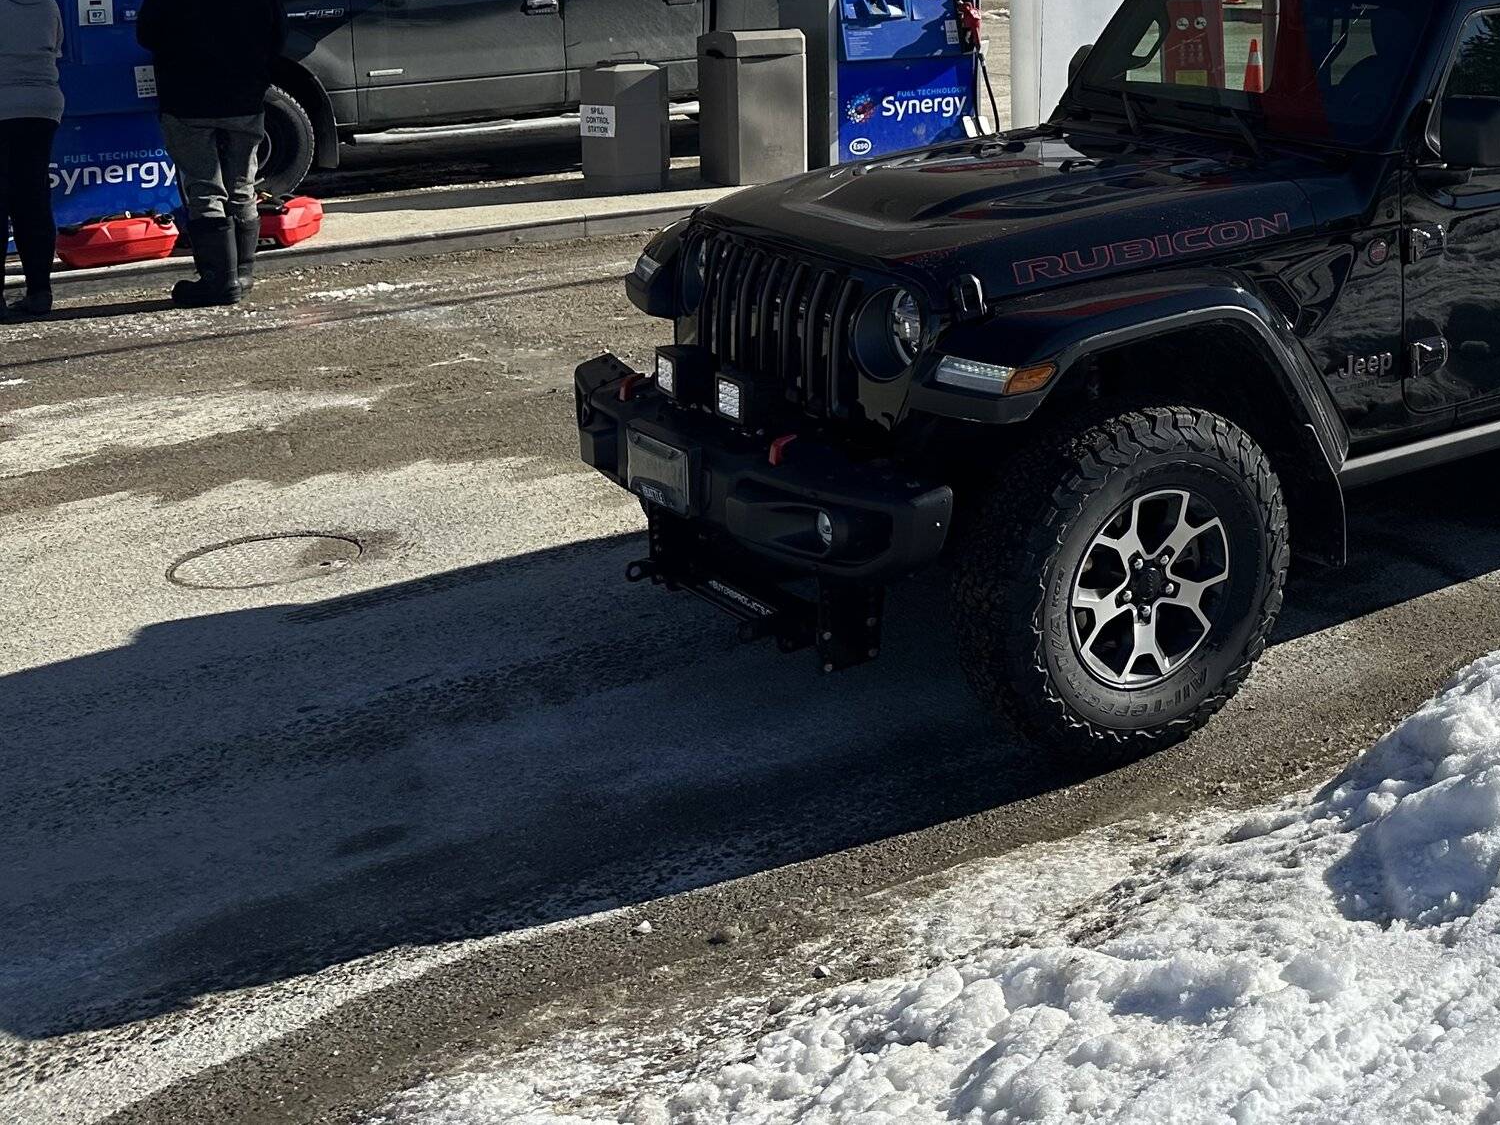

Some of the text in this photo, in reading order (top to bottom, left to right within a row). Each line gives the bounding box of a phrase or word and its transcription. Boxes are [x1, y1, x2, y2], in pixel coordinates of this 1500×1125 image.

[896, 85, 967, 98] FUEL TECHNOLOGY
[881, 94, 967, 122] Synergy
[586, 115, 610, 125] CONTROL
[63, 148, 168, 164] FUEL TECHNOLO
[852, 141, 869, 151] Esso
[48, 161, 177, 195] Synergy
[1012, 212, 1291, 285] RUBICON
[1337, 351, 1394, 380] Jeep
